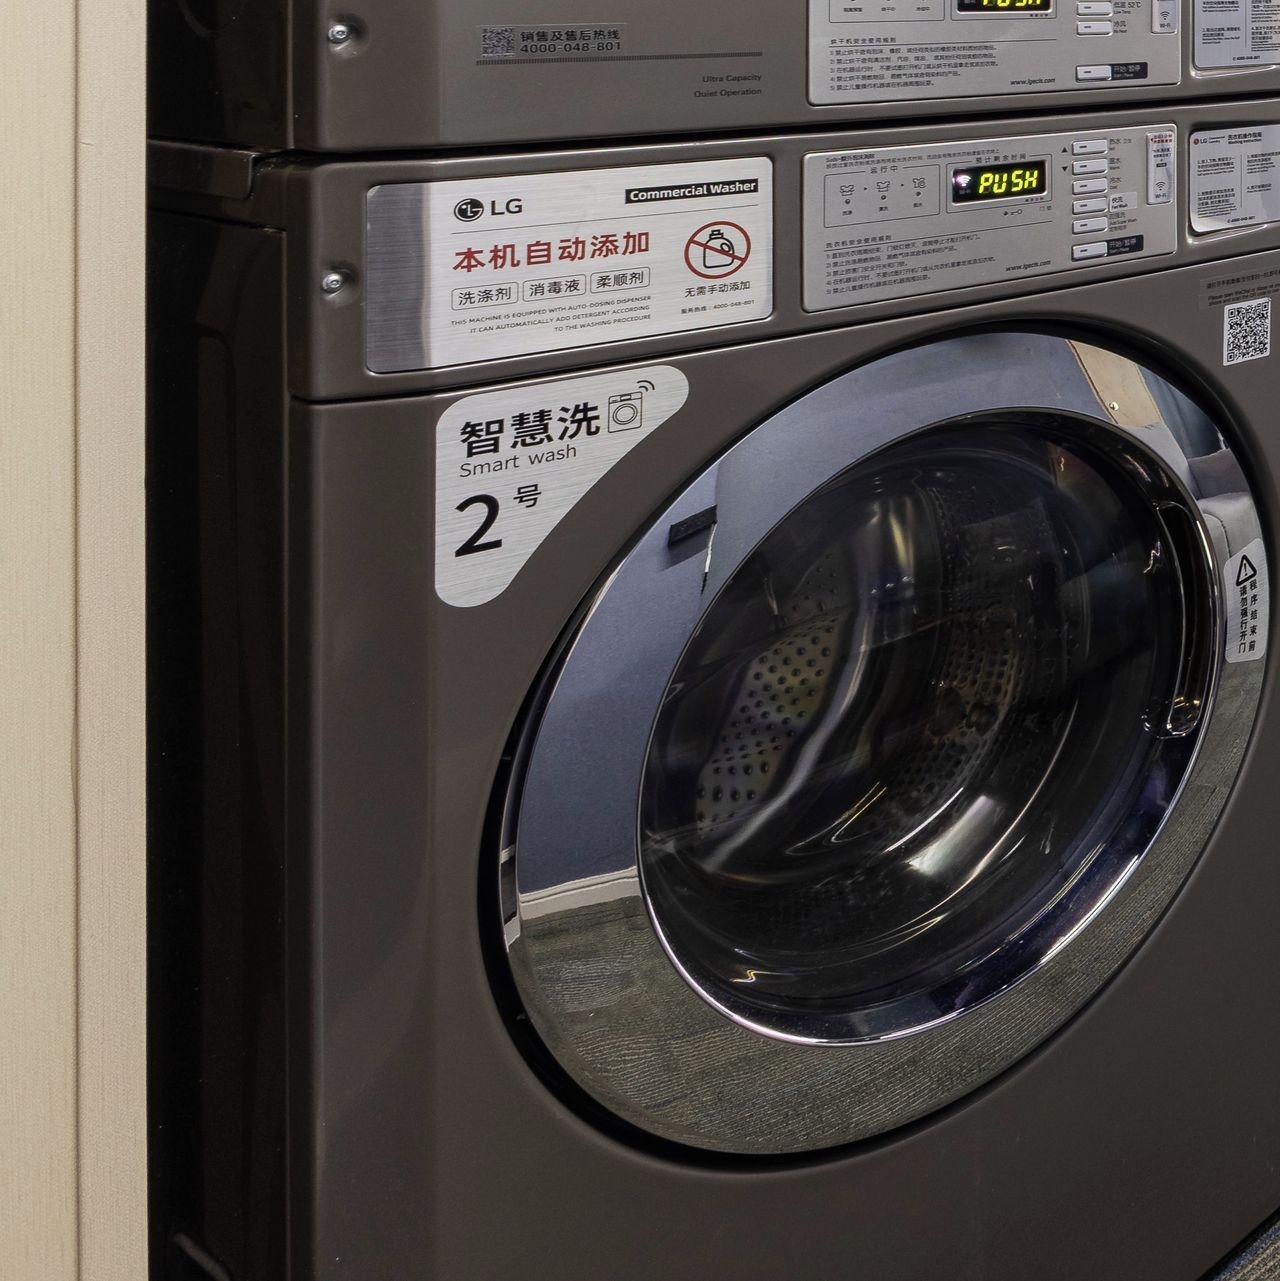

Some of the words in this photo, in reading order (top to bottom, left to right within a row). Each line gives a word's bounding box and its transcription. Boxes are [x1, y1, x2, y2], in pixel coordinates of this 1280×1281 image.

[520, 30, 620, 43] 销售及售后热线
[520, 42, 621, 53] 4000-048-801
[726, 74, 762, 84] Capacity
[720, 88, 762, 97] Operation
[630, 185, 707, 201] Commercial
[710, 180, 756, 195] Washer
[978, 170, 1039, 194] PUSH
[491, 199, 523, 216] LG
[452, 231, 650, 273] 本机自动添加
[529, 278, 580, 299] 消毒液
[596, 271, 644, 290] 柔顺剂
[684, 280, 750, 298] 无需手动添加
[458, 286, 512, 307] 洗涤剂
[469, 315, 502, 324] MACHINE
[512, 309, 547, 318] EQUIPPED
[568, 299, 615, 311] AUTO-DOSING
[617, 295, 651, 305] DISPENSER
[478, 324, 494, 333] CAN
[496, 318, 554, 330] AUTOMATICALLY
[572, 310, 610, 320] DETERGENT
[612, 305, 650, 315] ACCORDING
[580, 319, 612, 328] WASHING
[613, 314, 651, 324] PROCEDURE
[460, 402, 600, 458] 智慧洗
[460, 454, 520, 478] Smart
[528, 444, 577, 465] wash
[454, 493, 502, 558] 2
[513, 484, 542, 508] 号
[1238, 585, 1248, 654] 请勿强行开门
[1249, 578, 1258, 652] 程序结束前
